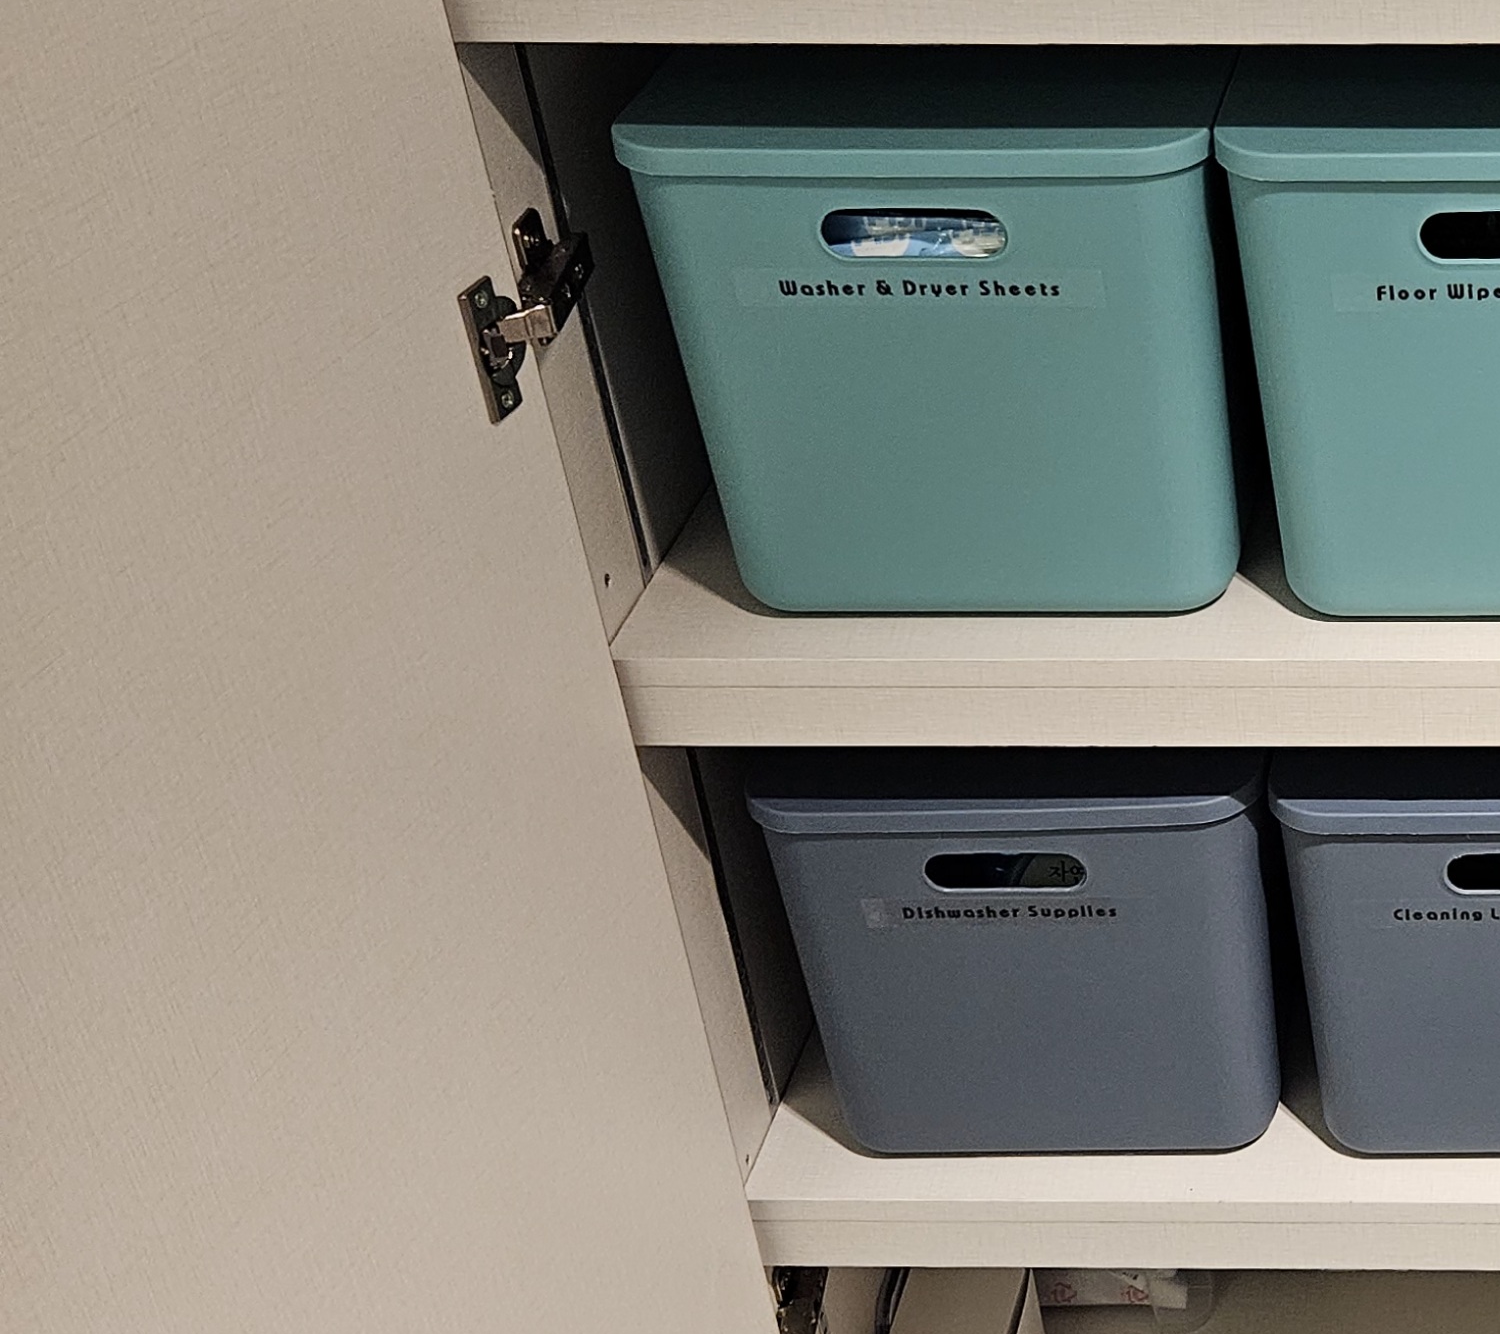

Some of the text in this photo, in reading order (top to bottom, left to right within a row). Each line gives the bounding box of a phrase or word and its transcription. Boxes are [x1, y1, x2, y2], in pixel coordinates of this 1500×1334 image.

[779, 280, 1061, 298] Washer & Dryer Sheets
[1376, 285, 1437, 301] Floor
[902, 905, 1118, 919] Dishwasher Supplies
[1393, 909, 1482, 921] Cleaning
